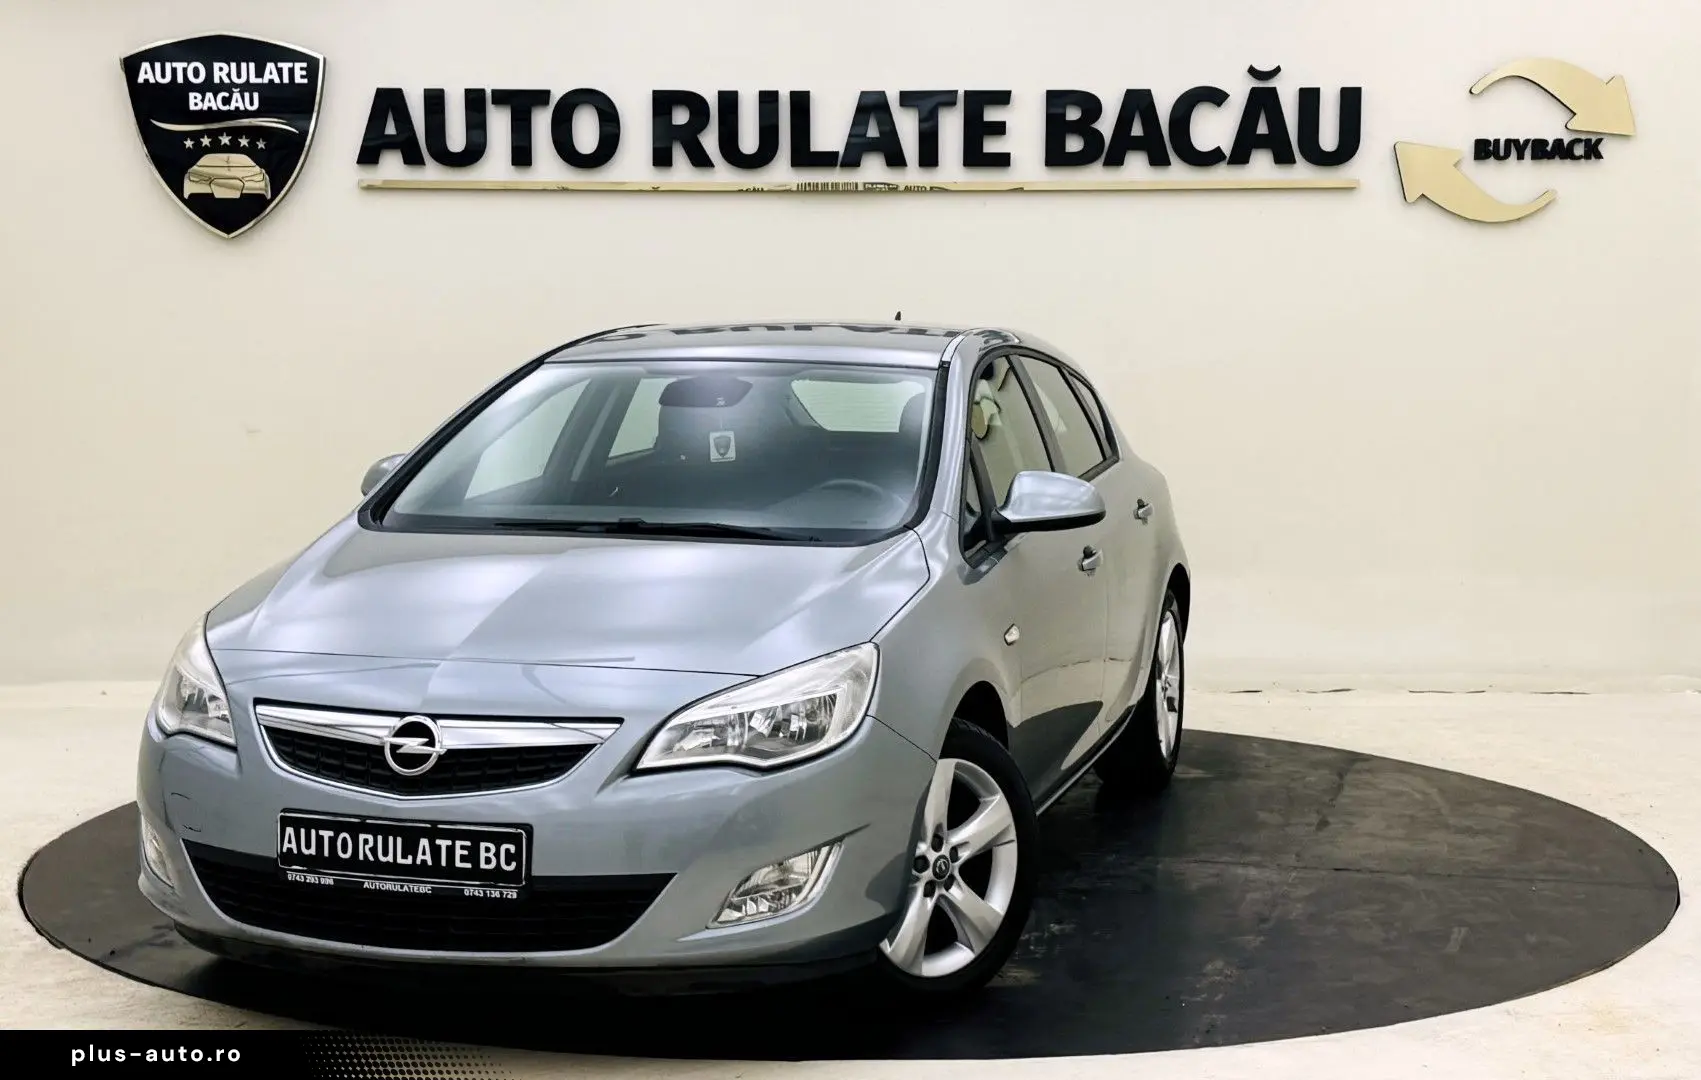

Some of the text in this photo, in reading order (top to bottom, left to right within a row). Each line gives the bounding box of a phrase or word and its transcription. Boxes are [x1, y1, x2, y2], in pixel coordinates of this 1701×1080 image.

[137, 61, 308, 84] AUTO RULATE
[188, 87, 260, 111] BACĂU
[356, 64, 1362, 169] AUTO RULATE BACĂU
[1473, 138, 1604, 161] BUYBACK
[282, 826, 516, 872] AUTO RULATE BC
